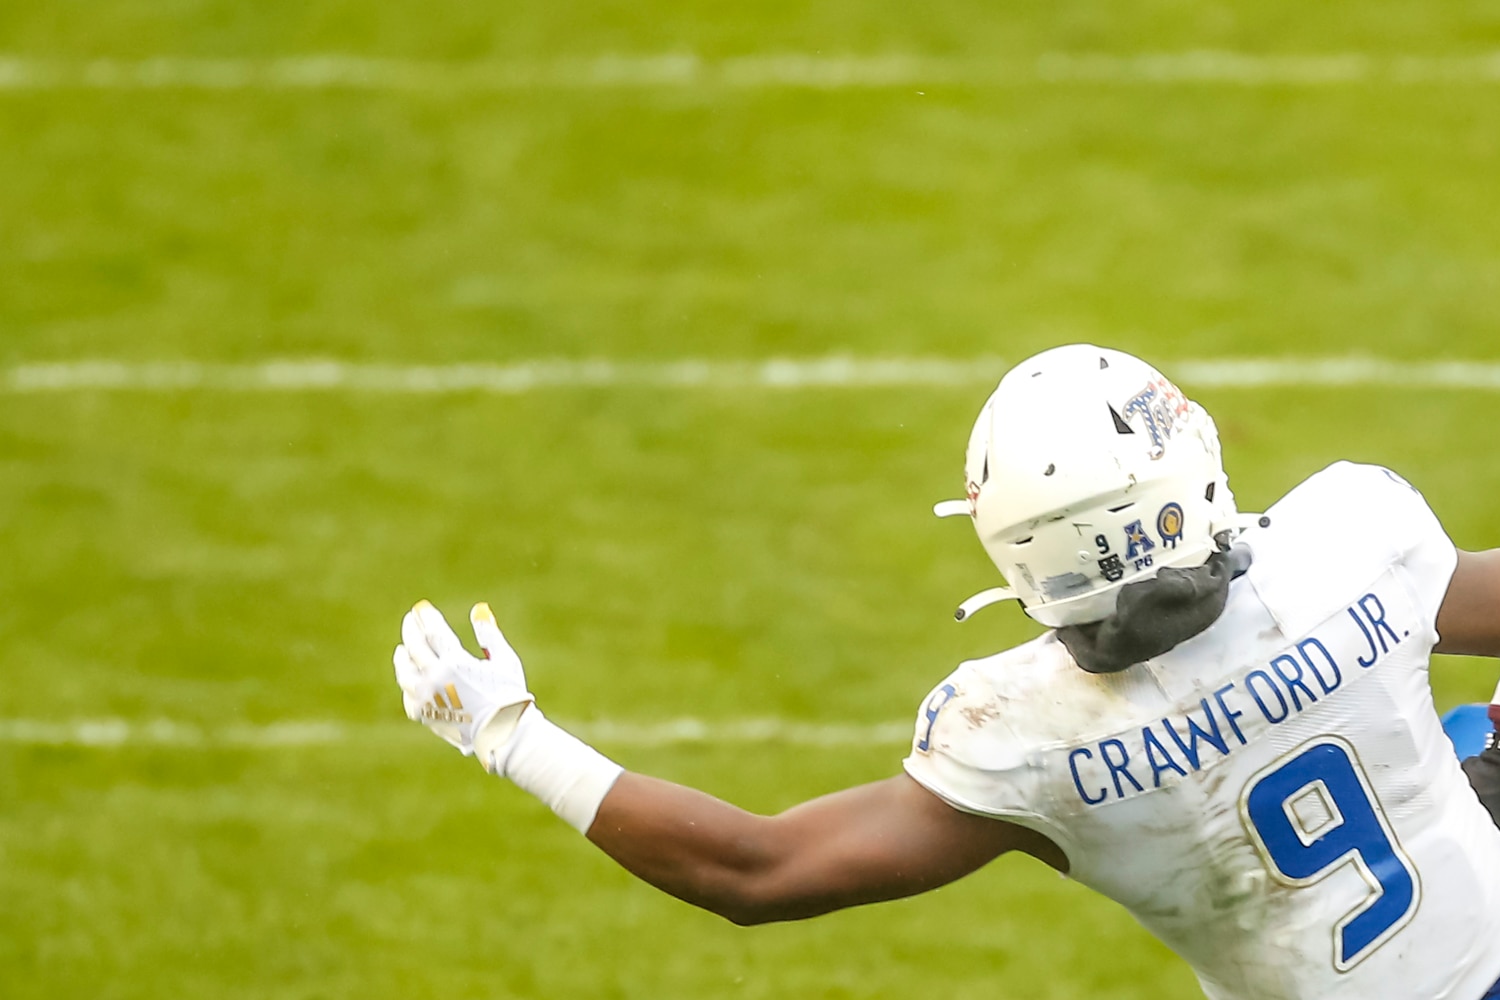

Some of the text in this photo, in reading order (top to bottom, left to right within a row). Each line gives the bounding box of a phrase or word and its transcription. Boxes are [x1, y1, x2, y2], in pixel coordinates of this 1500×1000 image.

[1068, 592, 1410, 805] CRAWFORD JR.
[1240, 734, 1421, 973] 9
